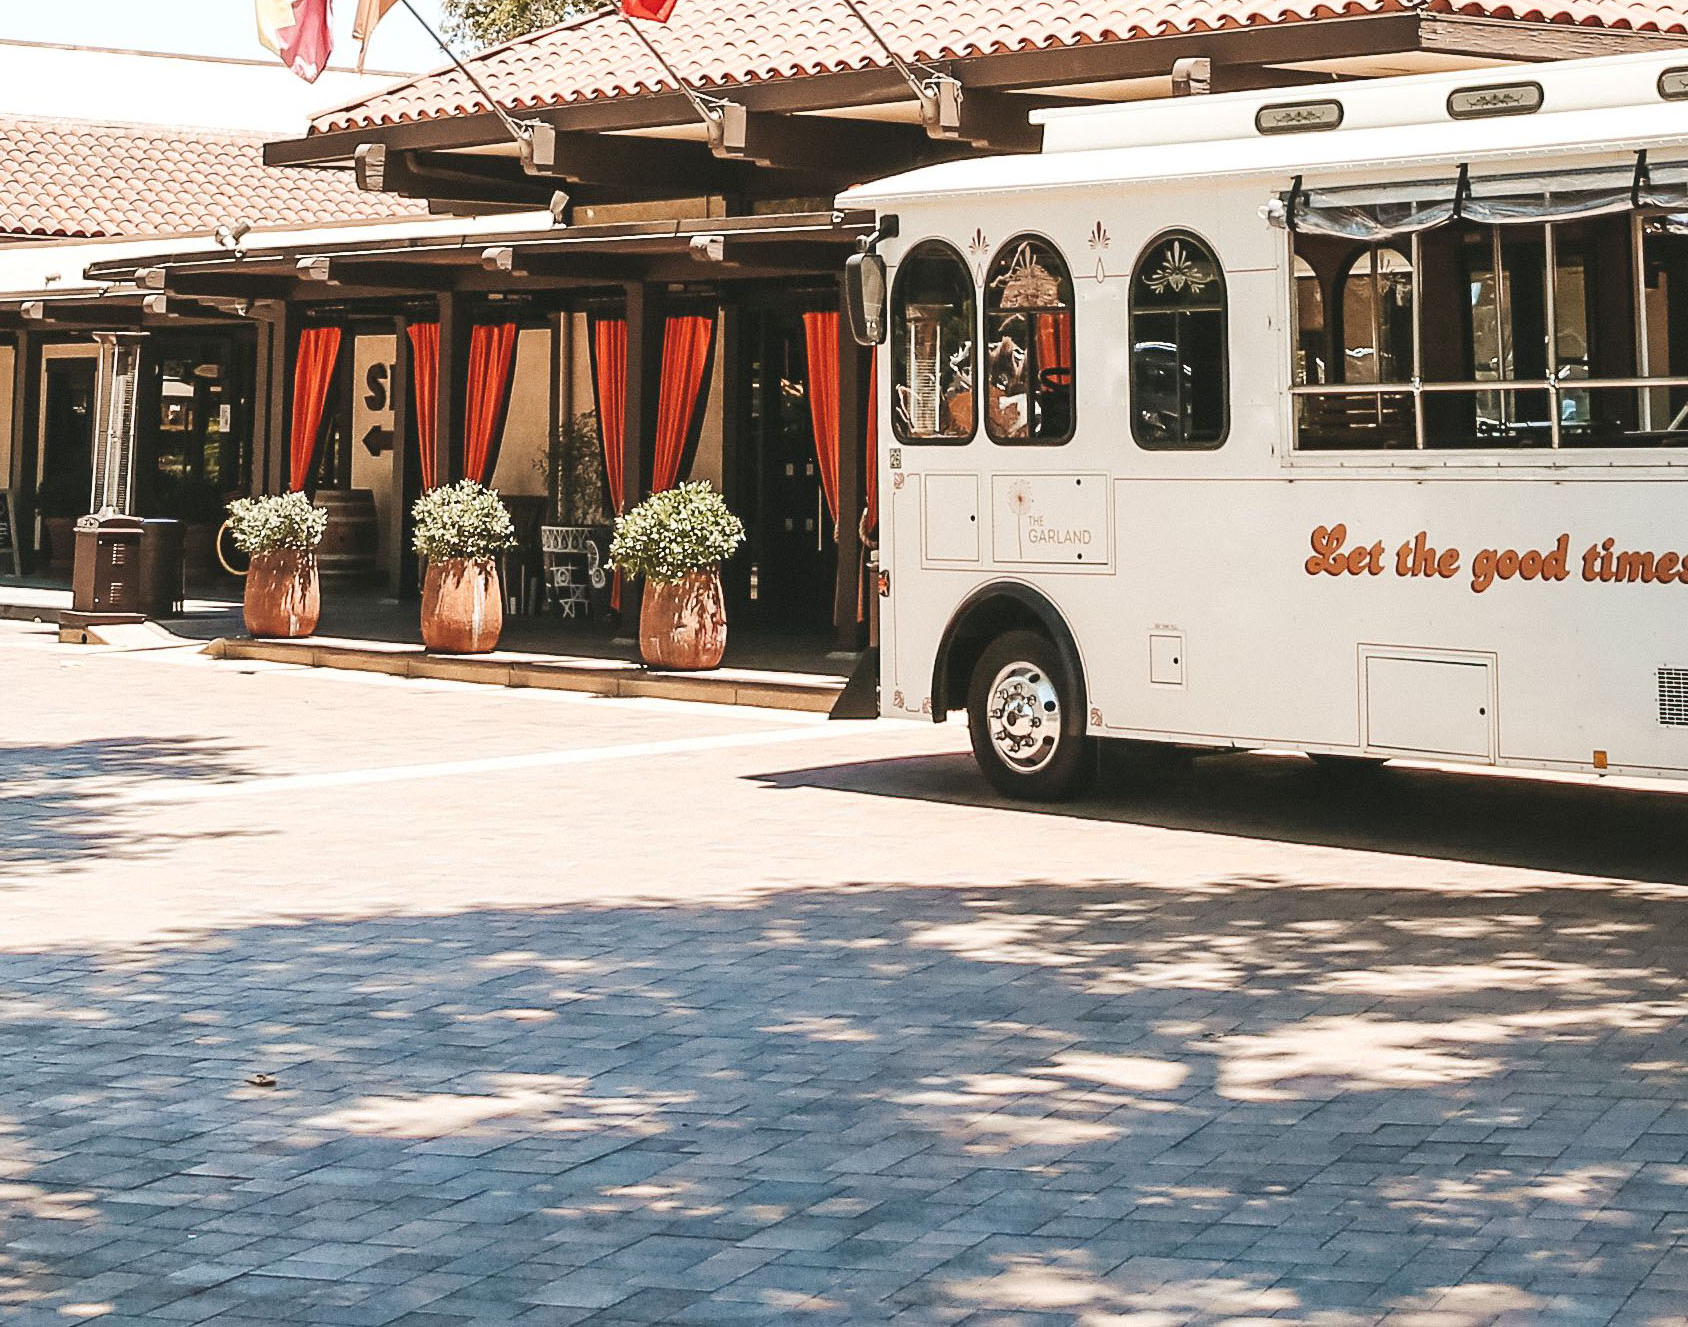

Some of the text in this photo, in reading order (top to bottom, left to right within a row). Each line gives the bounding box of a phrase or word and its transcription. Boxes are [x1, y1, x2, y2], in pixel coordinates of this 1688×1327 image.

[364, 362, 393, 411] S
[1028, 515, 1044, 526] THE
[1028, 528, 1092, 544] GARLAND
[1305, 523, 1385, 577] Let
[1396, 531, 1460, 578] the
[1470, 533, 1570, 594] good
